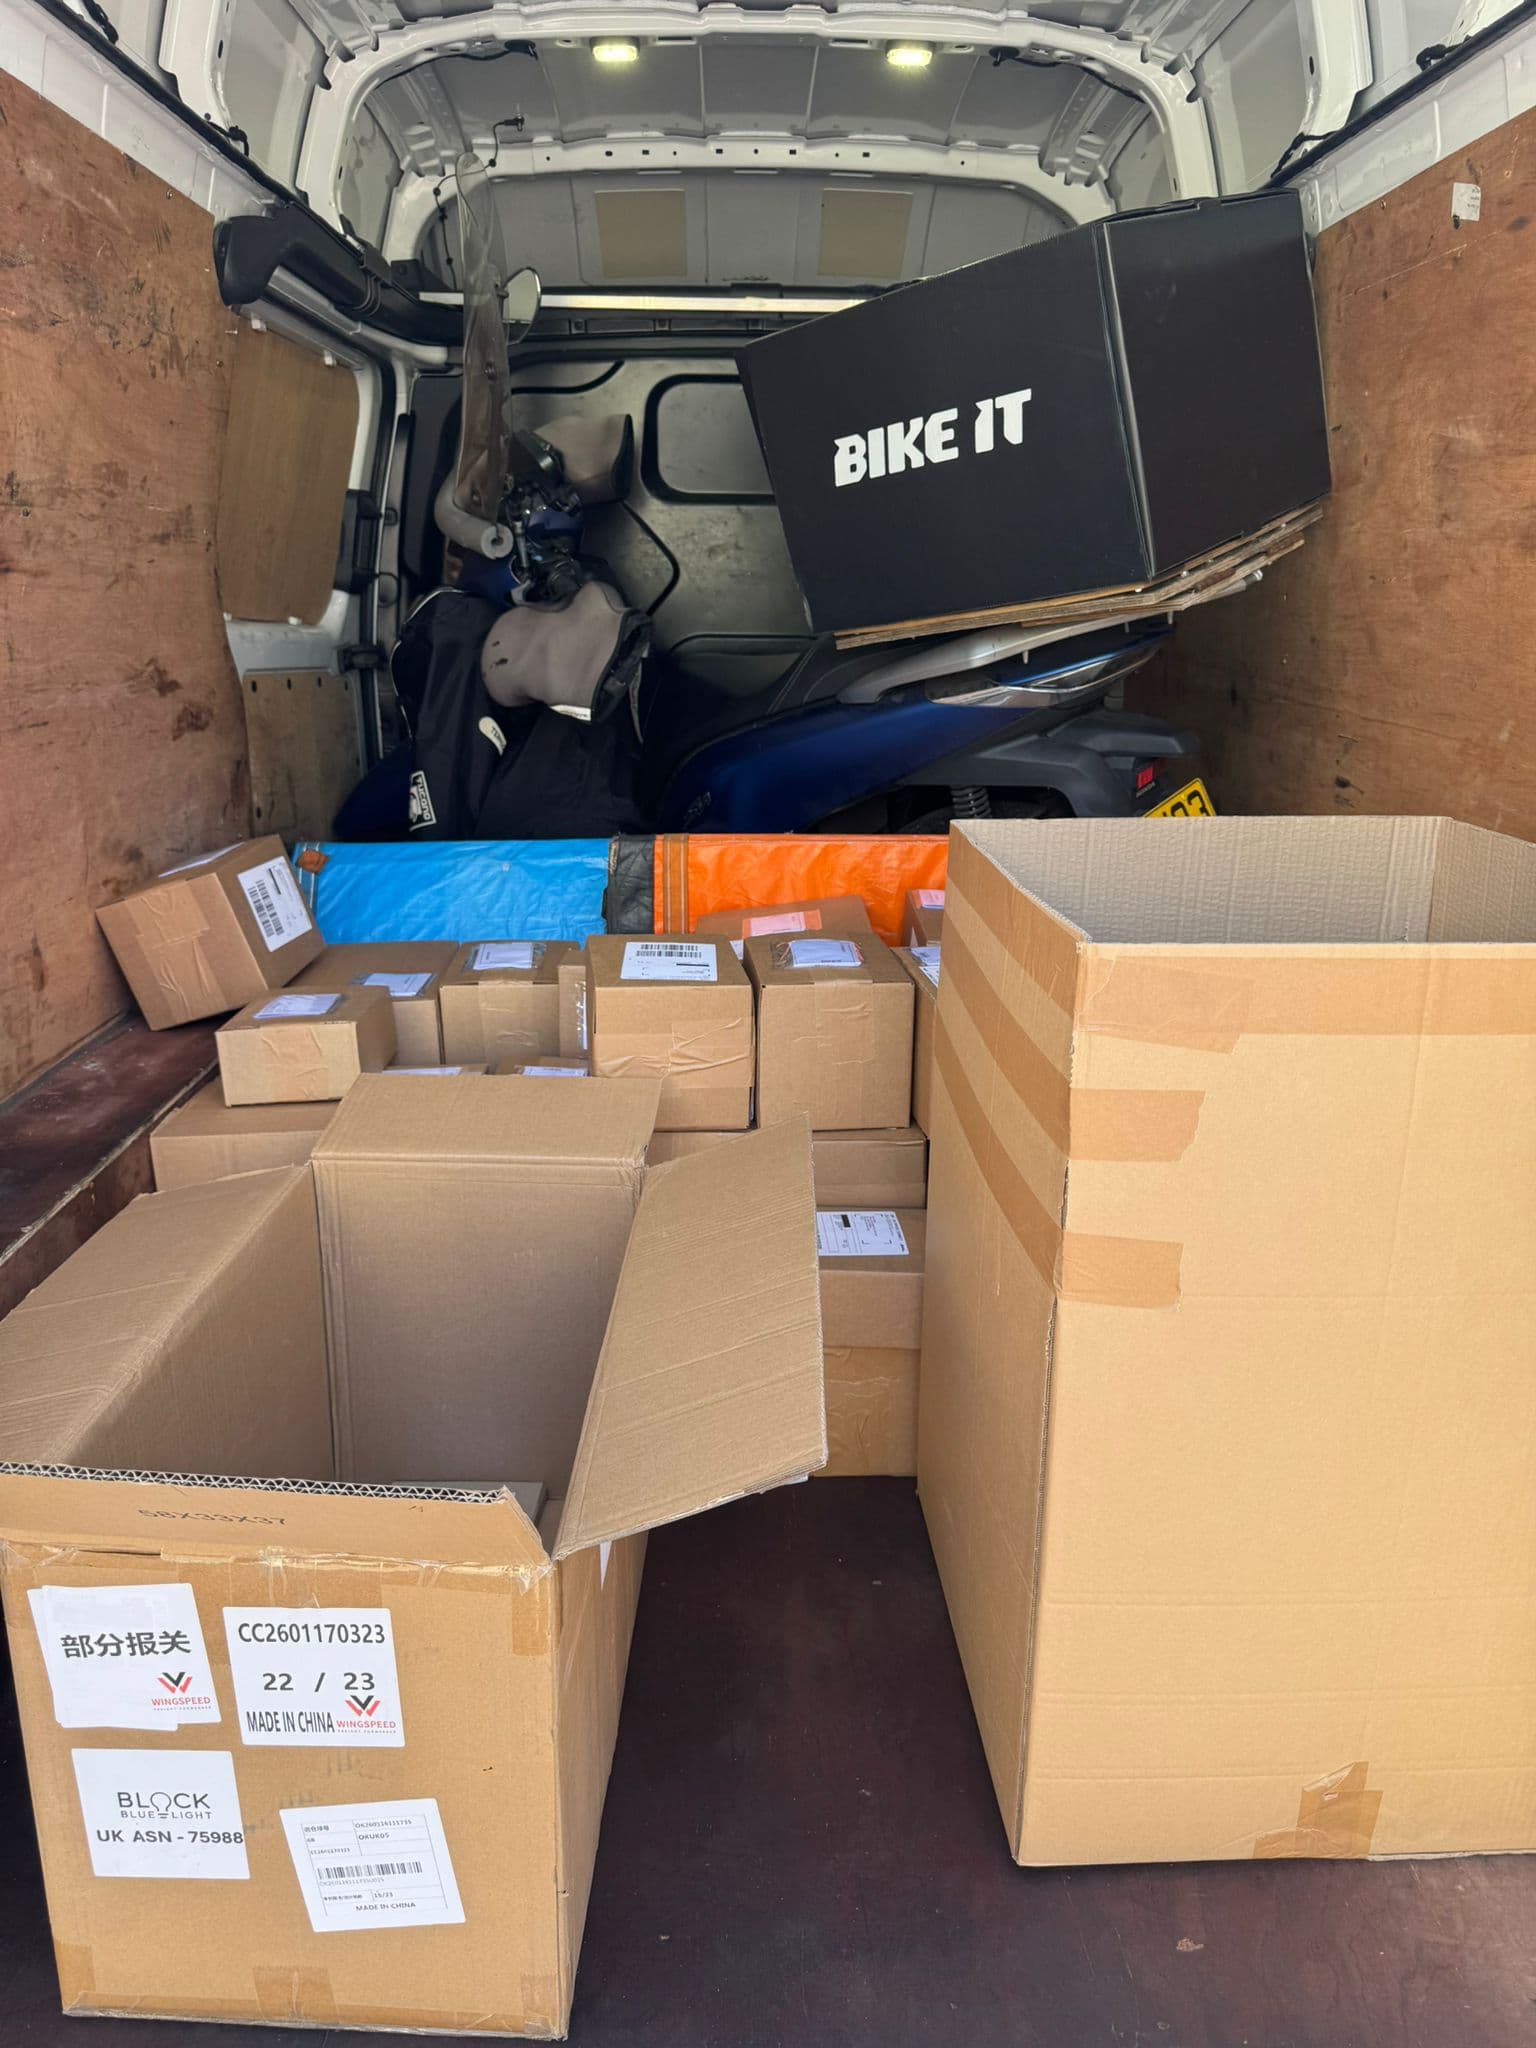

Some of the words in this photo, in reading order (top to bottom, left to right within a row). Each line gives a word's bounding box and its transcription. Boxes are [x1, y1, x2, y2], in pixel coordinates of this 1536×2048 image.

[833, 408, 959, 488] BIKE
[975, 388, 1032, 454] IT
[238, 1623, 385, 1644] CC2601170323
[60, 1630, 192, 1658] 部分报关
[262, 1672, 294, 1691] 22
[314, 1672, 326, 1693] /
[343, 1672, 375, 1691] 23
[151, 1696, 211, 1707] WINGSPEED
[246, 1711, 281, 1732] MADE
[284, 1711, 295, 1733] IN
[298, 1711, 335, 1733] CHINA
[336, 1720, 396, 1729] WINGSPEED
[117, 1791, 210, 1810] BLOCK
[121, 1810, 155, 1819] BLUE
[172, 1811, 212, 1820] LIGHT
[96, 1829, 124, 1842] UK
[133, 1830, 172, 1843] ASN
[187, 1831, 244, 1844] 75988
[355, 1903, 378, 1911] MADE
[380, 1902, 389, 1910] IN
[391, 1902, 416, 1910] CHINA
